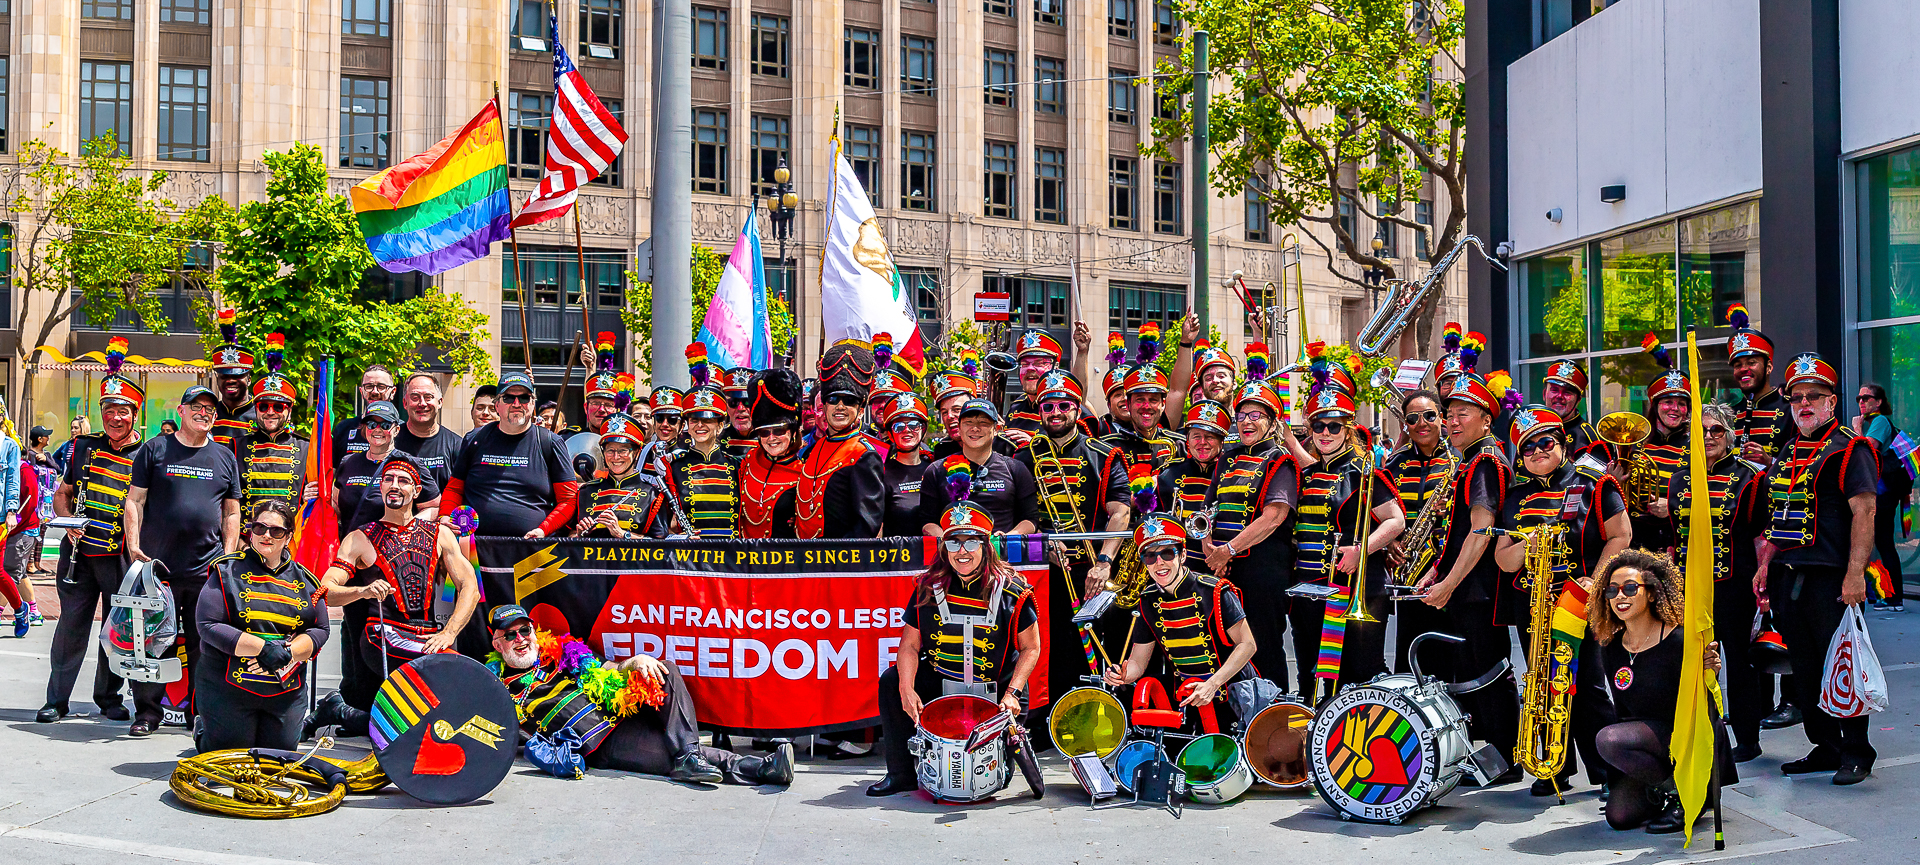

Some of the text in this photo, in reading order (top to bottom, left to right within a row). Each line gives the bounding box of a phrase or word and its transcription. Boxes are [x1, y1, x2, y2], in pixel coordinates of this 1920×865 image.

[166, 467, 196, 476] FREEDOM
[583, 547, 911, 565] PLAYING WITH PRIDE SINCE 1978
[611, 604, 906, 630] SAN FRANCISCO LESB
[602, 632, 859, 680] FREEDOM
[1314, 691, 1417, 807] SAN FRANCISCO LESBIAN/GAY
[951, 760, 962, 789] YAMAHA
[1364, 730, 1435, 818] FREEDOM BAND
